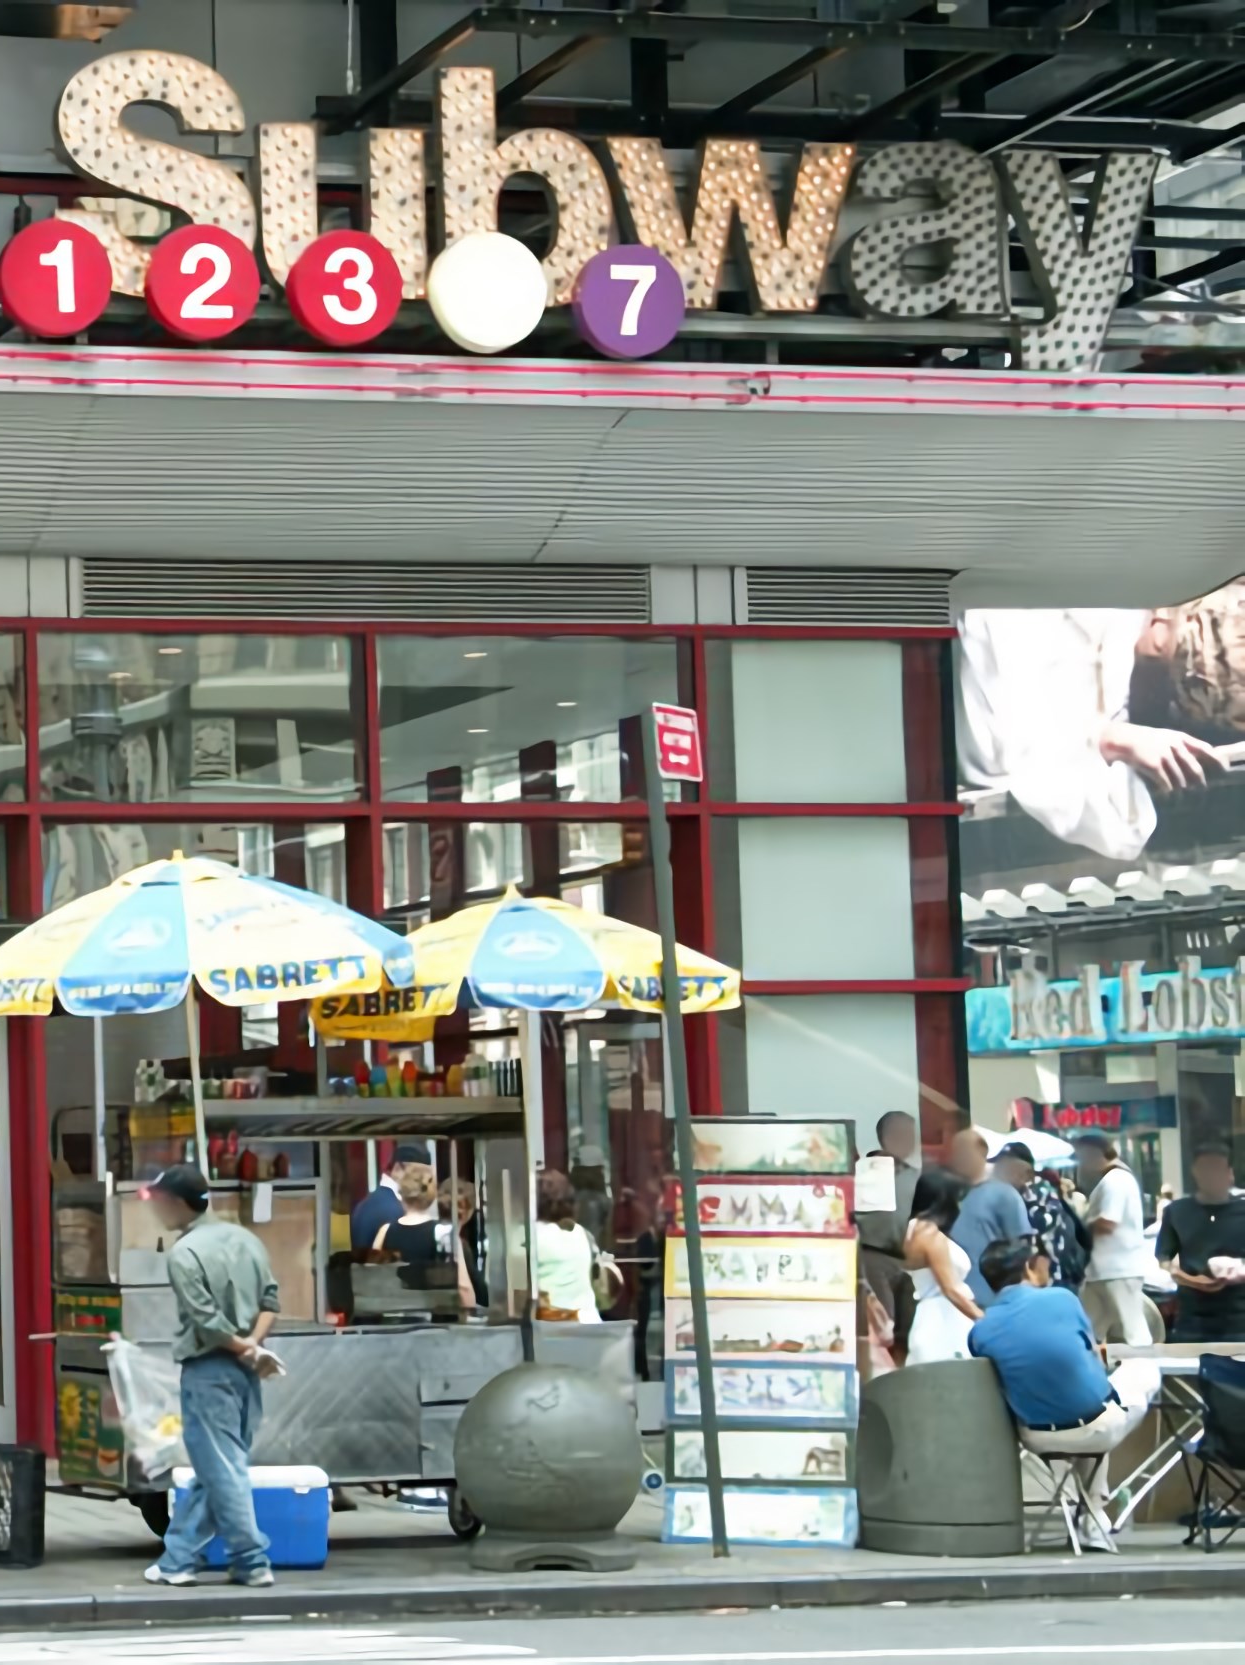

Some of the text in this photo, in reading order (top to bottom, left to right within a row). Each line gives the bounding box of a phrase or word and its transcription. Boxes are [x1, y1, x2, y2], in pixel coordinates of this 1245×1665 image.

[55, 49, 1160, 372] Subway
[39, 239, 76, 312] 1
[179, 242, 234, 319] 2
[322, 247, 378, 325] 3
[609, 265, 657, 336] 7
[208, 953, 367, 996] SABRETT
[617, 974, 729, 1001] SABETT
